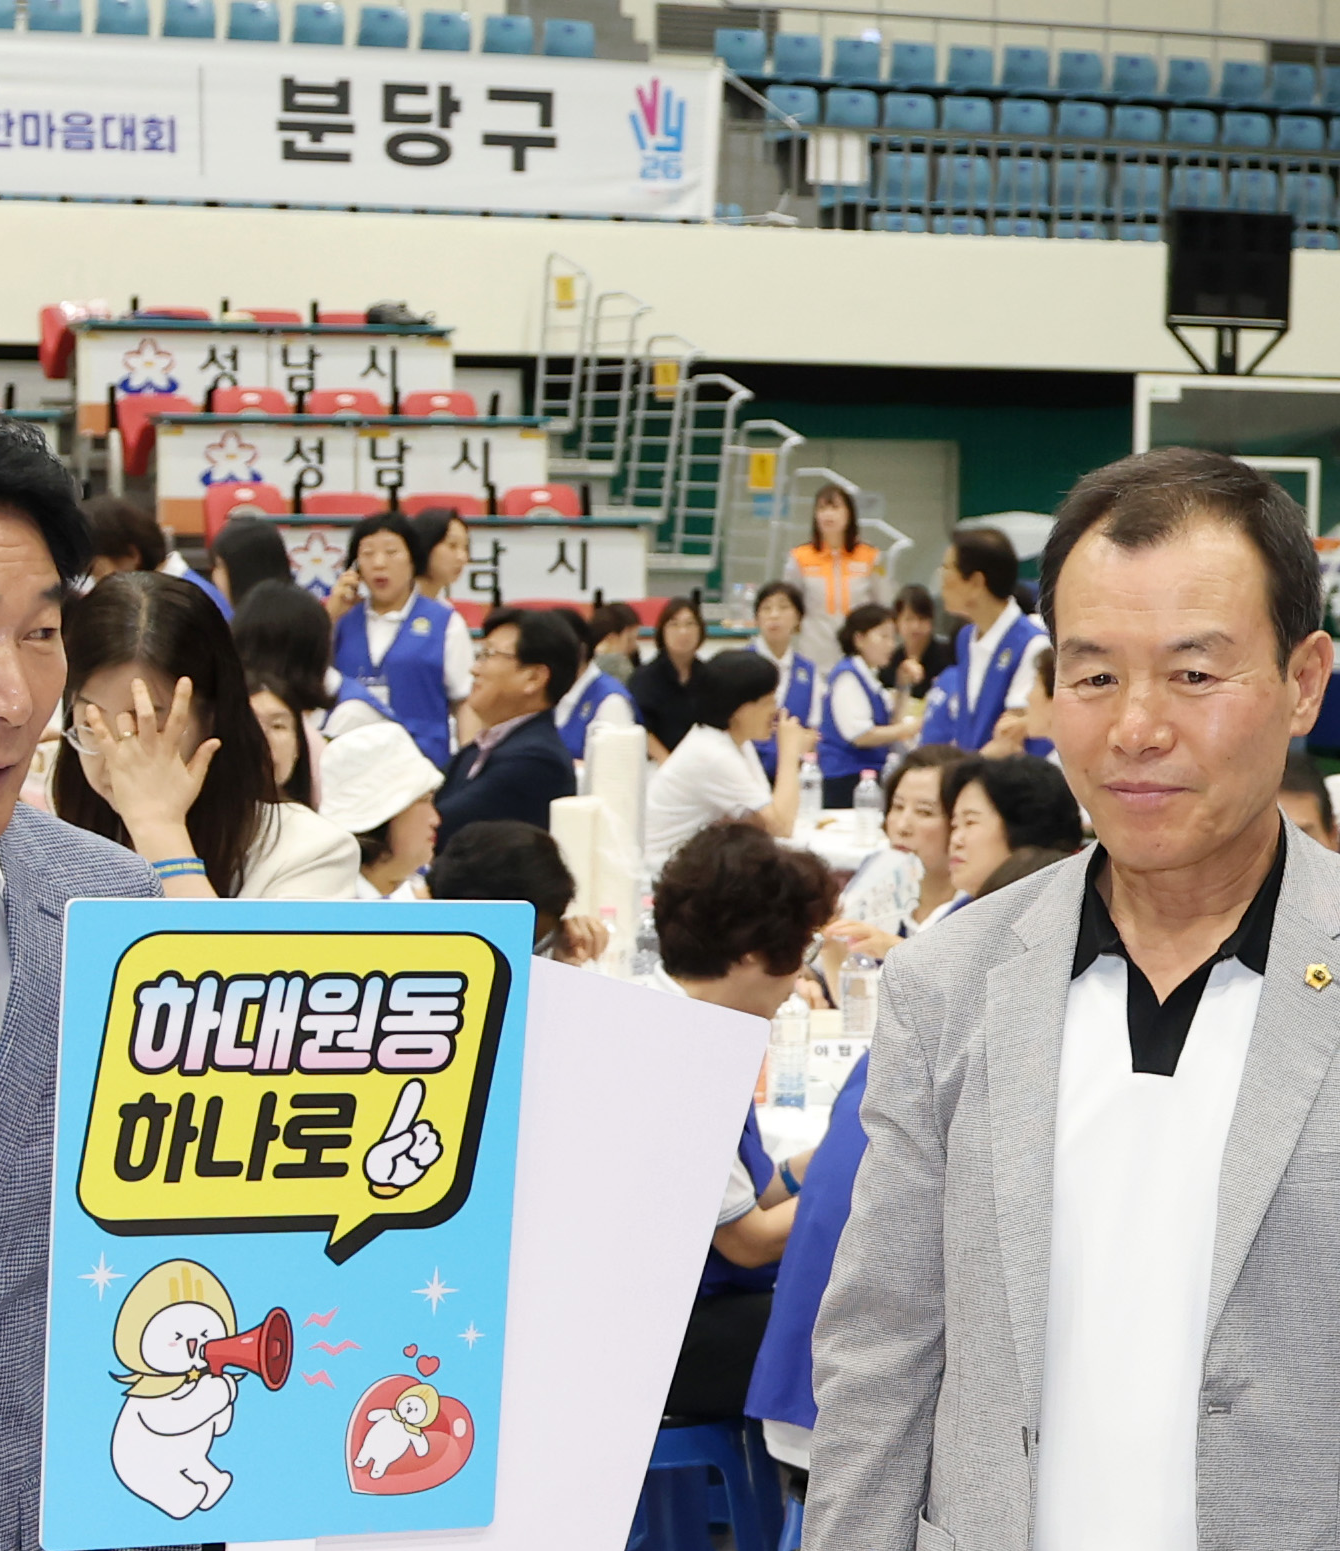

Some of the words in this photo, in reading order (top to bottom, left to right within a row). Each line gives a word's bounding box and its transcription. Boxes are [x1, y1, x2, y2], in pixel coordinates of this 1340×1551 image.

[276, 76, 558, 172] 분당구
[129, 970, 468, 1075] 하대원동
[113, 1091, 357, 1183] 하나로
